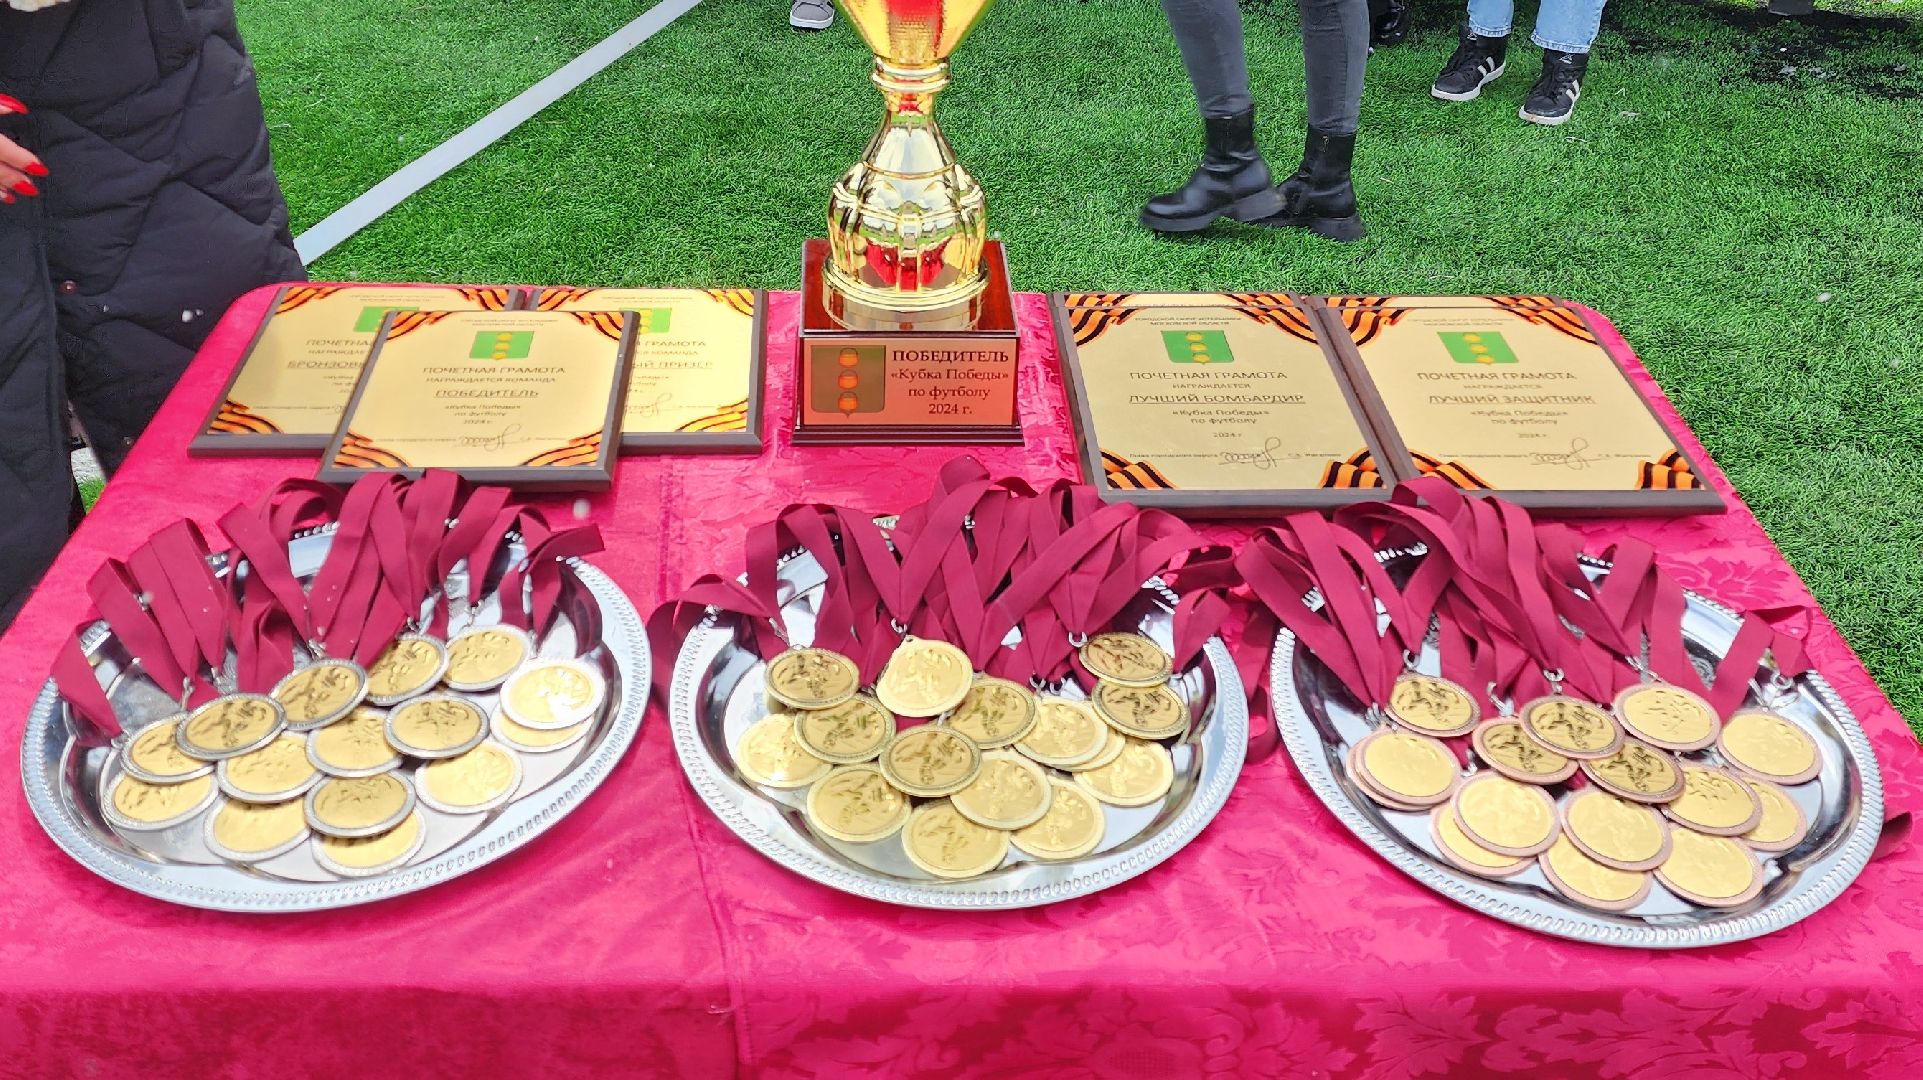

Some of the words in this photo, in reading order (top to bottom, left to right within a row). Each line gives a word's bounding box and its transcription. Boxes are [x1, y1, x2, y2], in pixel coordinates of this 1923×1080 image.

[892, 350, 1009, 364] ПОБЕДИТЕЛЬ
[422, 366, 496, 374] ПОЧЕТНАЯ
[499, 366, 566, 374] ГРАМОТА
[891, 368, 942, 383] «Кубка
[946, 368, 1009, 381] Победы»
[1129, 371, 1211, 380] ПОЧЕТНАЯ
[1214, 371, 1288, 380] ГРАМОТА
[1416, 372, 1498, 380] ПОЧЕТНАЯ
[1502, 372, 1576, 380] ГРАМОТА
[435, 389, 540, 398] ПОБЕДИТЕЛЬ
[908, 388, 926, 397] по
[929, 386, 991, 400] футболу
[1130, 393, 1200, 404] ЛУЧШИЙ
[1203, 395, 1305, 404] БОМБАРДИР
[1429, 394, 1498, 404] ЛУЧШИЙ
[1501, 394, 1594, 404] ЗАЩИТНИК
[928, 403, 959, 415] 2024
[961, 405, 973, 415] г.
[1208, 417, 1257, 425] футболу
